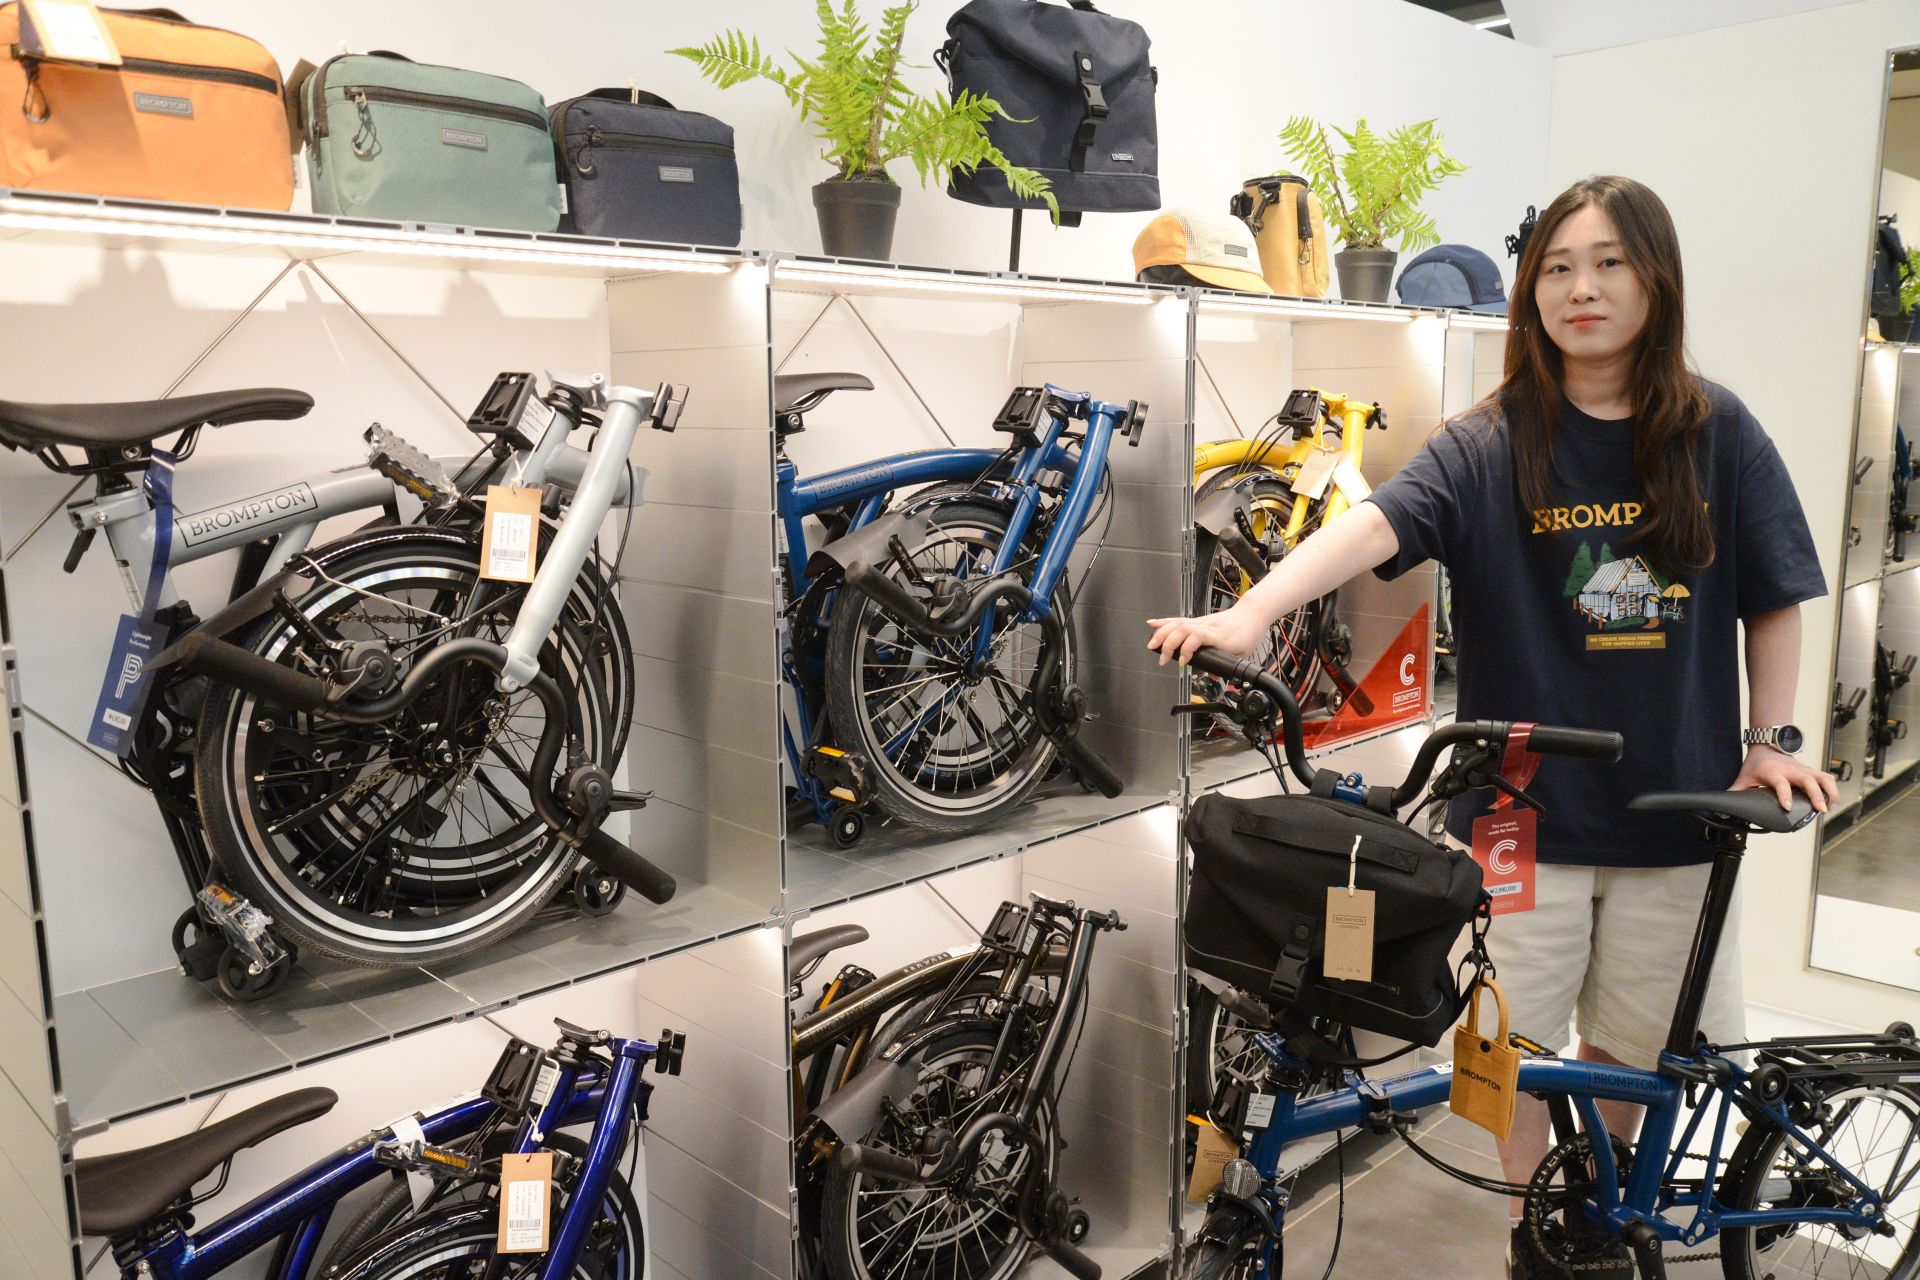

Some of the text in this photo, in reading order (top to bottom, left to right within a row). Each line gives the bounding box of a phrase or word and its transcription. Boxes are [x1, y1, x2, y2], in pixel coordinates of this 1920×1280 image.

[140, 97, 186, 110] BROMPTON
[445, 131, 483, 144] BROMPTON
[818, 463, 889, 494] BROMPTON
[188, 489, 307, 537] BROMPTON
[1400, 653, 1416, 686] C
[1394, 690, 1419, 704] BROMPTON
[1489, 839, 1518, 875] C
[1335, 916, 1364, 924] BROMPTON
[1460, 1066, 1502, 1092] BROMPTON
[1592, 1072, 1658, 1091] BROMPTON
